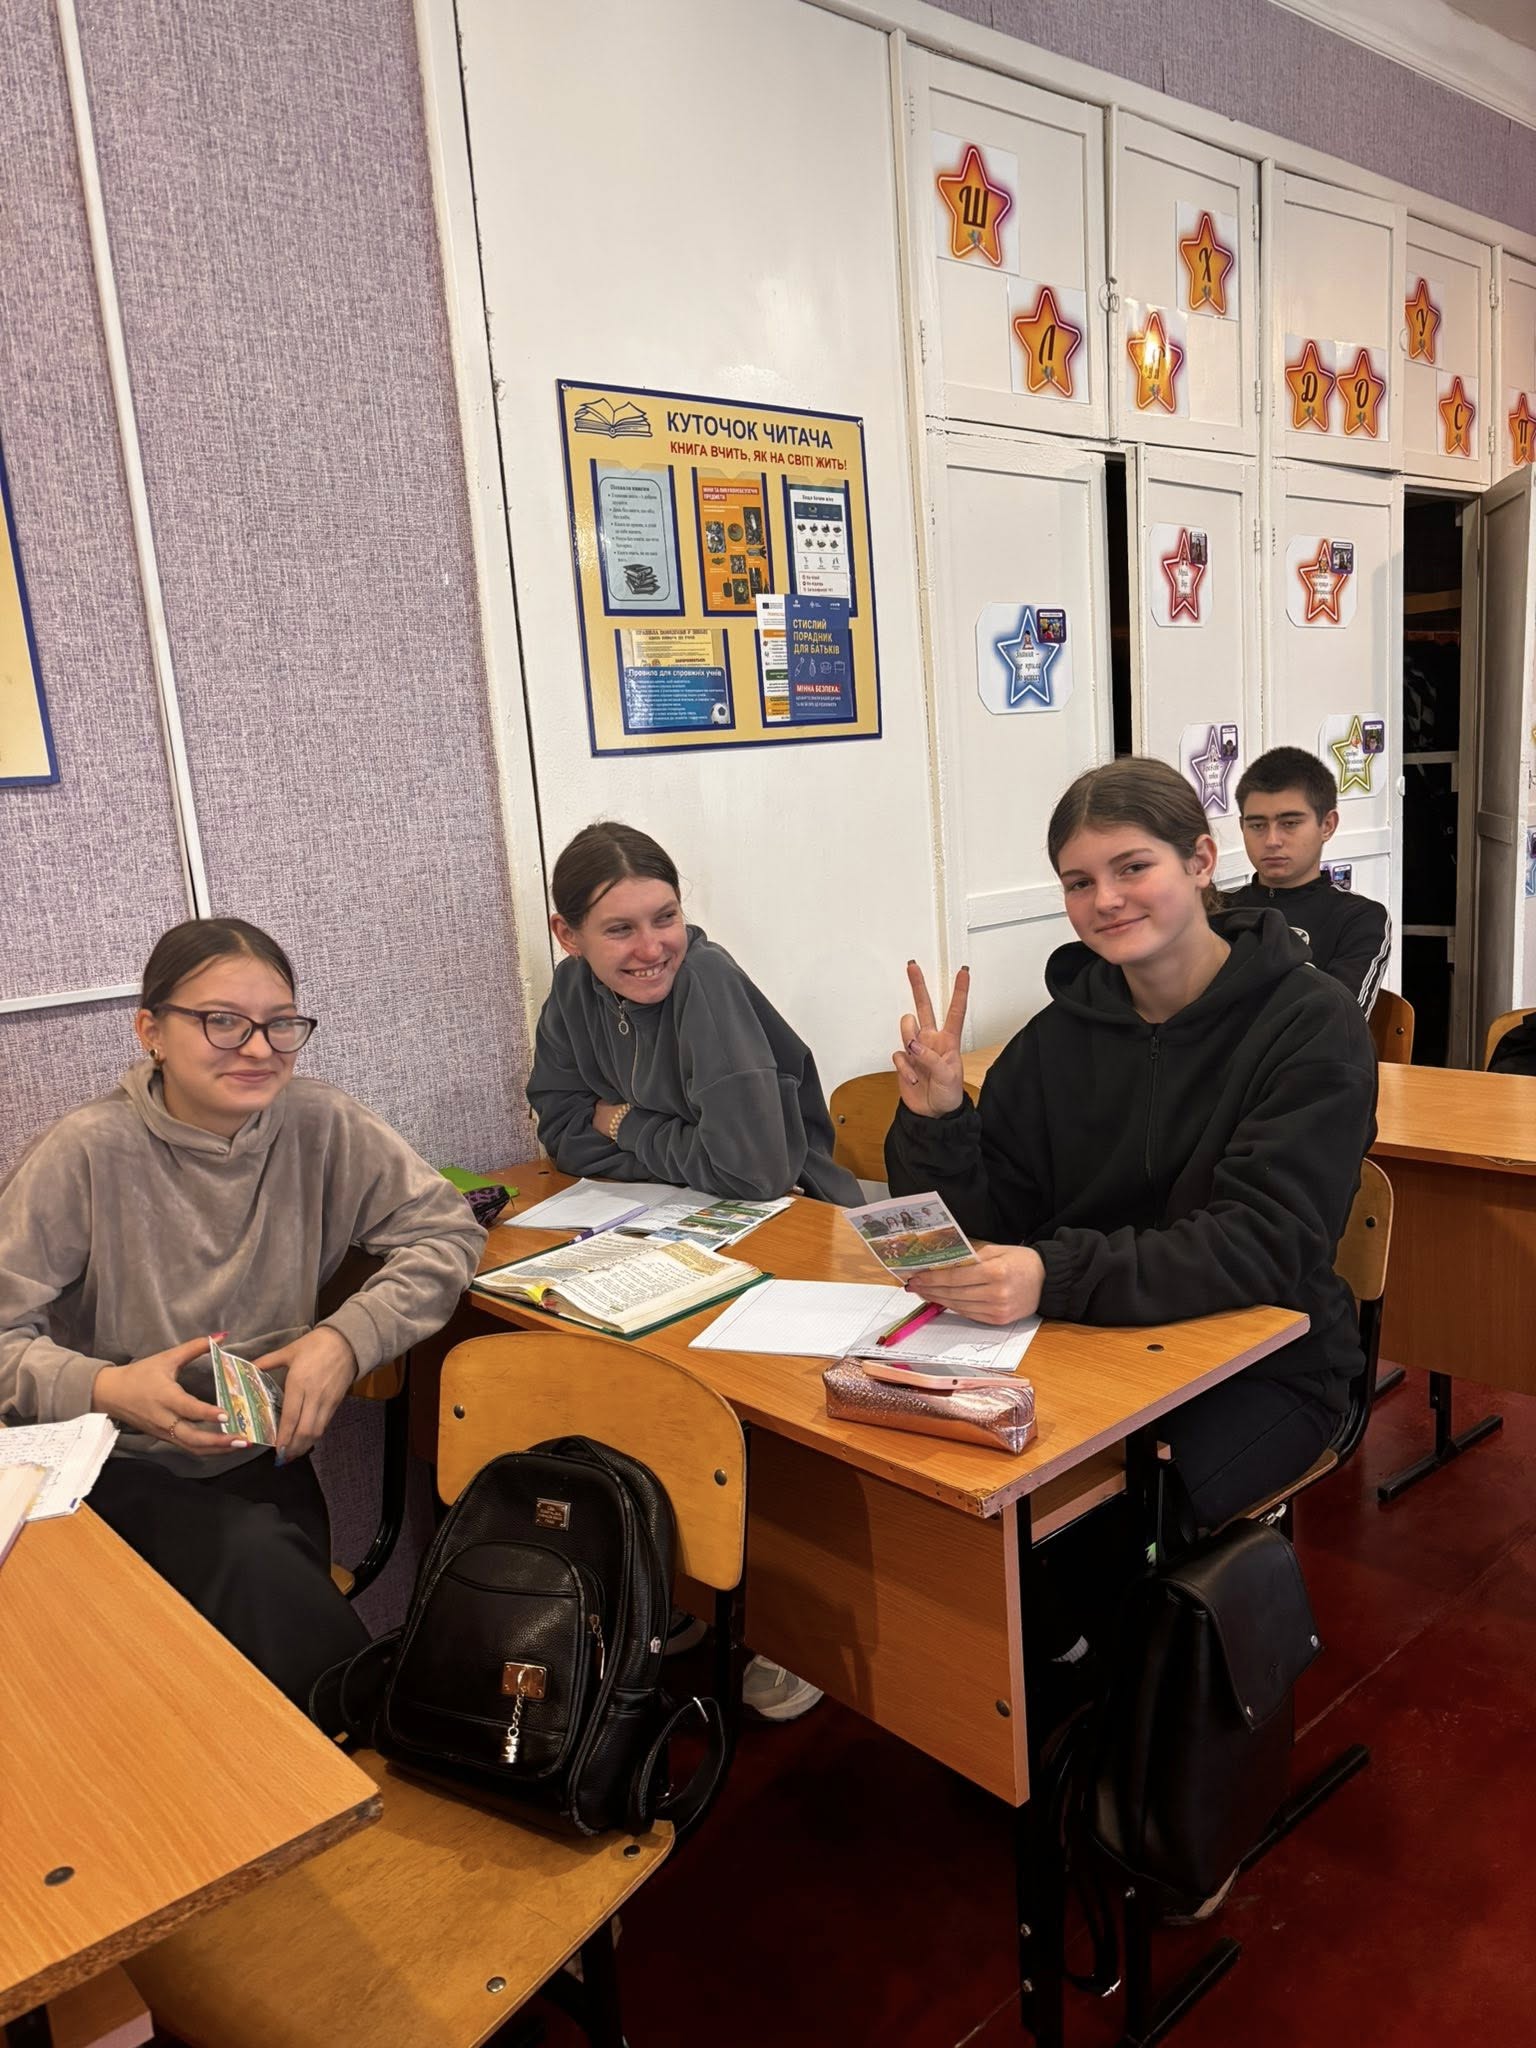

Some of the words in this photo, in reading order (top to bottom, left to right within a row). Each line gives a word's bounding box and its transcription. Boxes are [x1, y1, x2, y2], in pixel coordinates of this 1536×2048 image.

[667, 411, 758, 441] КУТОЧОК
[763, 423, 833, 449] ЧИТАЧА
[670, 441, 708, 456] КНИГА
[711, 445, 751, 462] ВЧИТЬ,
[753, 450, 768, 463] ЯК
[770, 452, 785, 464] НА
[787, 453, 814, 467] СВІТІ
[816, 456, 848, 470] ЖИТЬ!
[793, 618, 827, 630] СТИСЛИЙ
[793, 631, 832, 642] ПОРАДНИК
[794, 643, 809, 655] ДЛЯ
[810, 644, 840, 655] БАТЬКІВ
[659, 669, 671, 677] для
[706, 669, 722, 678] учнів
[796, 685, 814, 693] МІННА
